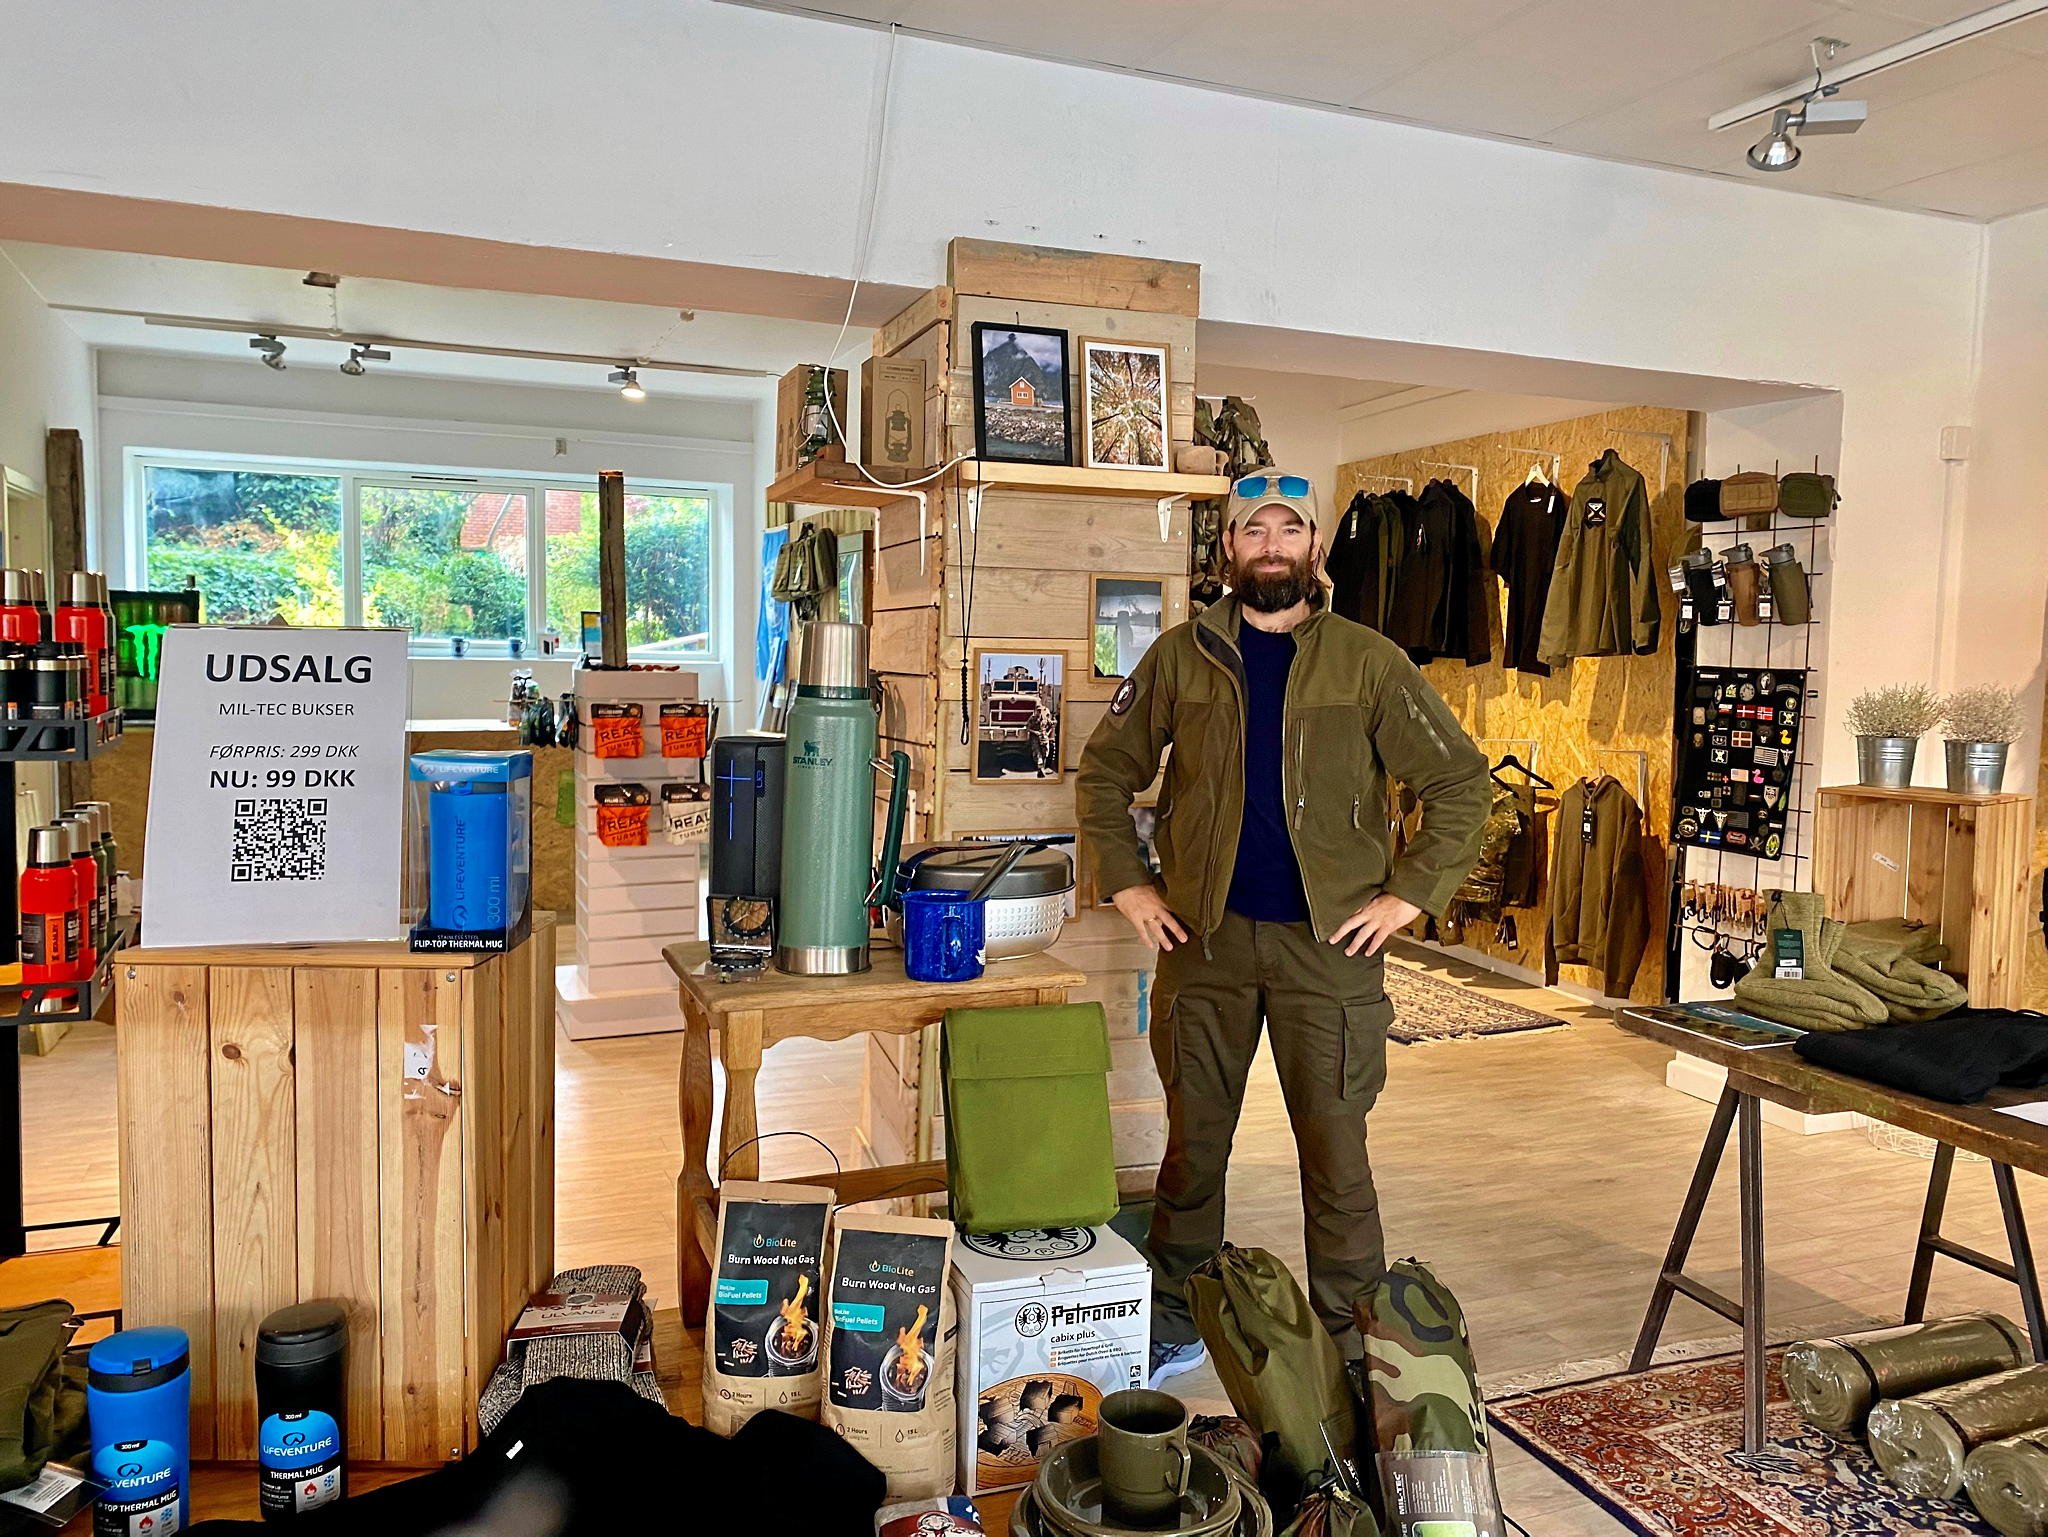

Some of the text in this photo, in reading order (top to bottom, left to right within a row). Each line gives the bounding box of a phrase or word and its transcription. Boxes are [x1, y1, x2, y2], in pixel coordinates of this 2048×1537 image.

[206, 653, 372, 683] UDSALG
[219, 703, 355, 716] MIL-TEC BUKSER
[209, 743, 360, 760] FØRPRIS: 299 DKK
[439, 765, 499, 774] LIFEVENTURE
[792, 756, 833, 767] STANLEY
[209, 769, 356, 788] NU: 99 DKK
[680, 828, 709, 840] TURMA
[455, 822, 467, 901] LIFEVENTURE
[487, 876, 500, 924] 300 ml
[414, 940, 503, 948] FLIP-TOP THERMAL MUG
[766, 1238, 797, 1248] BioLite
[728, 1254, 815, 1265] Burn Wood Not Gas
[882, 1264, 915, 1277] BioLite
[842, 1277, 936, 1294] Burn Wood Not Gas
[1052, 1298, 1143, 1327] Petromax
[1050, 1329, 1096, 1344] cabix plus
[851, 1427, 868, 1435] Hours
[263, 1436, 332, 1457] LIFEVENTURE
[106, 1467, 171, 1489] VENTURE
[270, 1464, 324, 1480] THERMAL MUG
[120, 1499, 159, 1513] THERMAL
[160, 1489, 177, 1504] MUG
[1393, 1471, 1405, 1515] MIL-TEC
